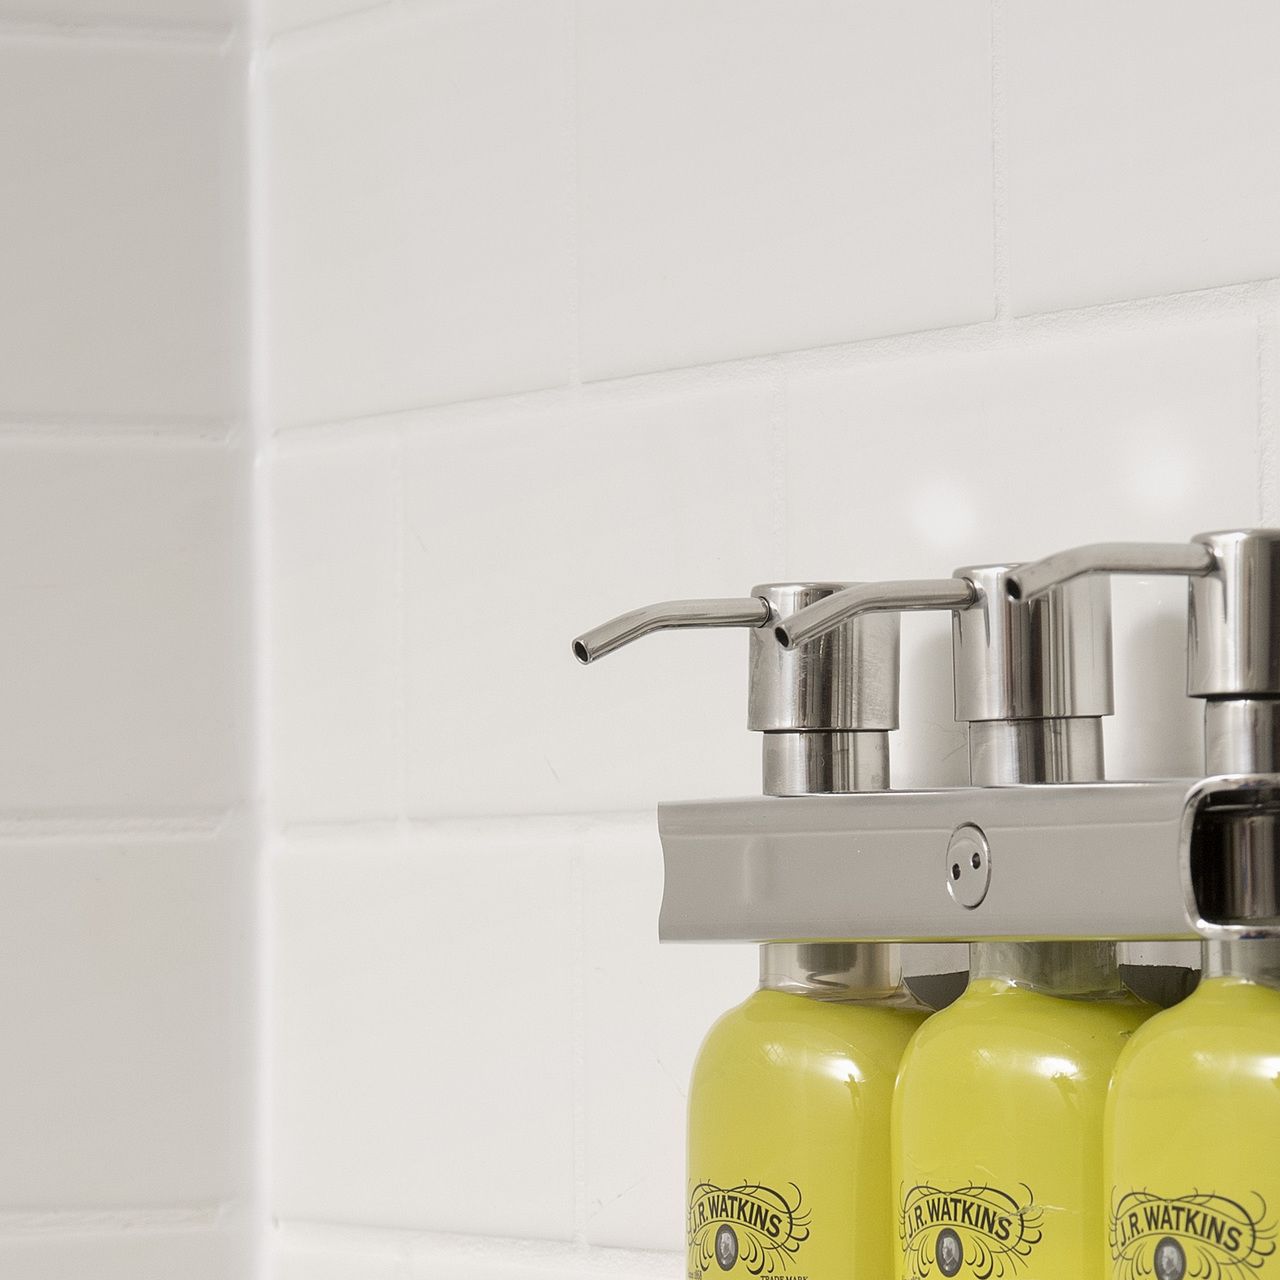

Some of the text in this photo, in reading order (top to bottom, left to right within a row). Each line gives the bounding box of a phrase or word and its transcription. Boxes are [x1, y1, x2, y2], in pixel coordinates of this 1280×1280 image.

[707, 1195, 782, 1238] WATKINS
[906, 1197, 1012, 1241] J.R. WATKINS
[1120, 1205, 1242, 1252] J.R. WATKINS
